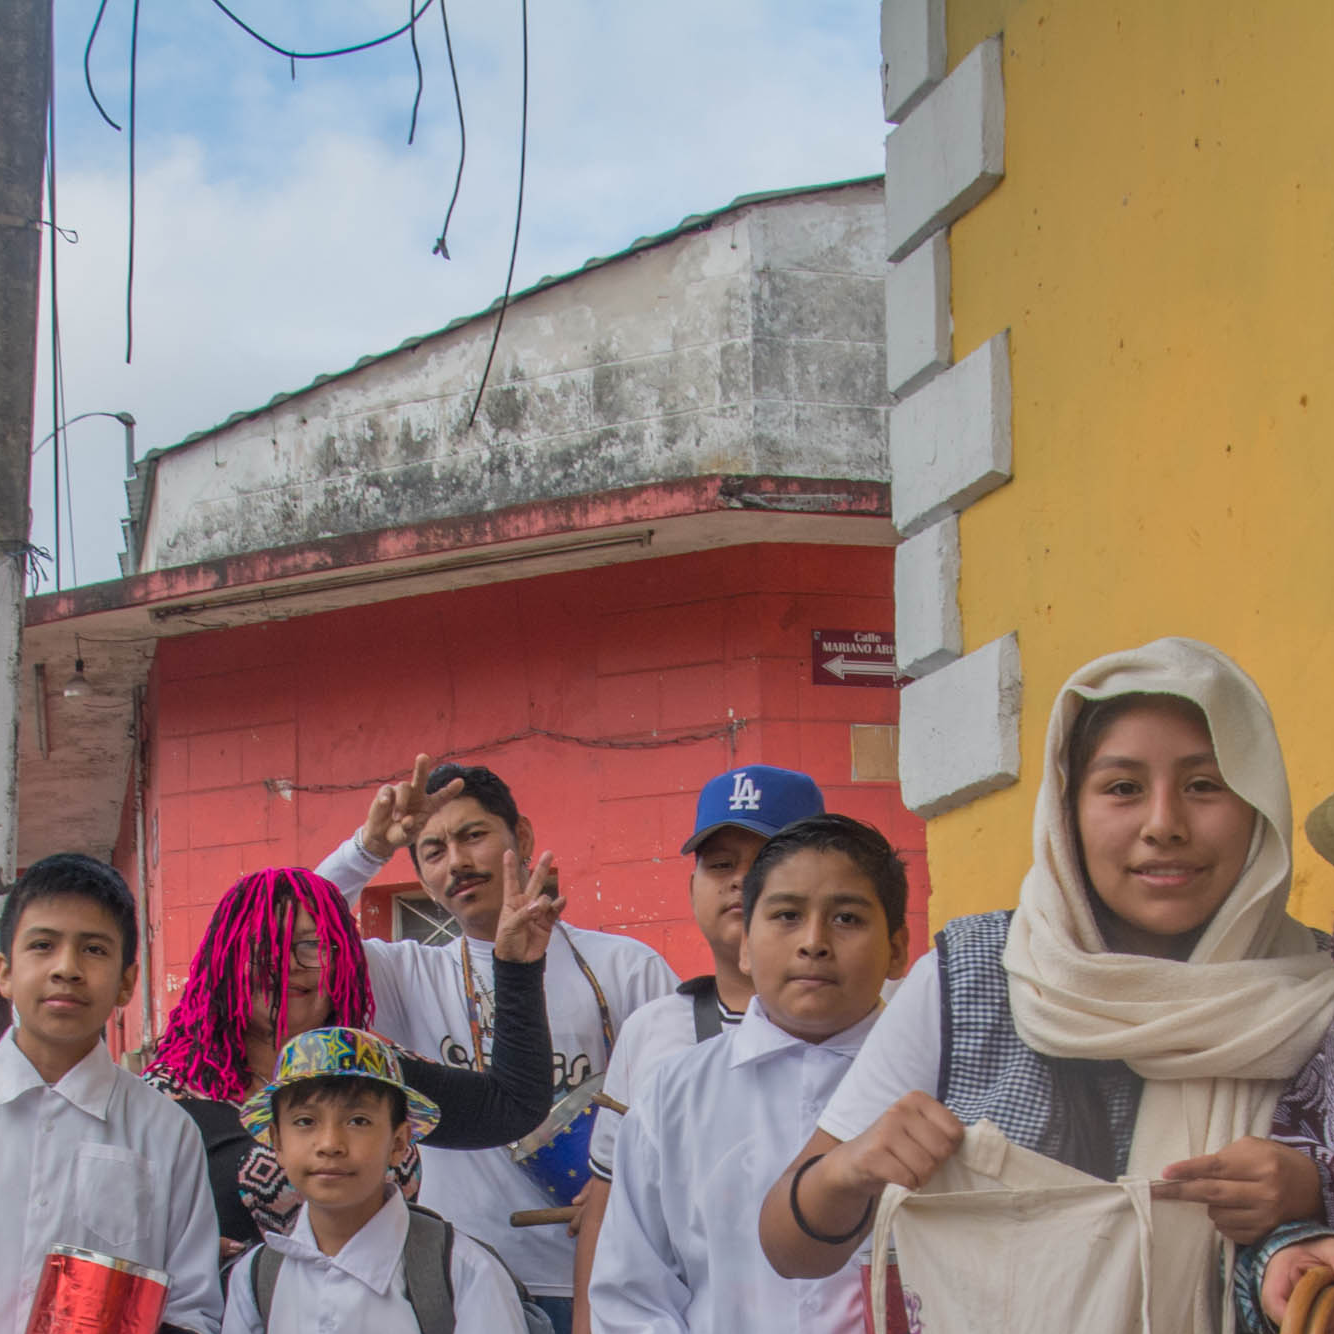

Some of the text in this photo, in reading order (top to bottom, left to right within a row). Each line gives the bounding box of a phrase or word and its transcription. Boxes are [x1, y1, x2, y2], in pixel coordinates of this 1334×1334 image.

[853, 632, 882, 643] Calle
[822, 641, 895, 655] MARIANO ARI
[729, 772, 762, 810] LA
